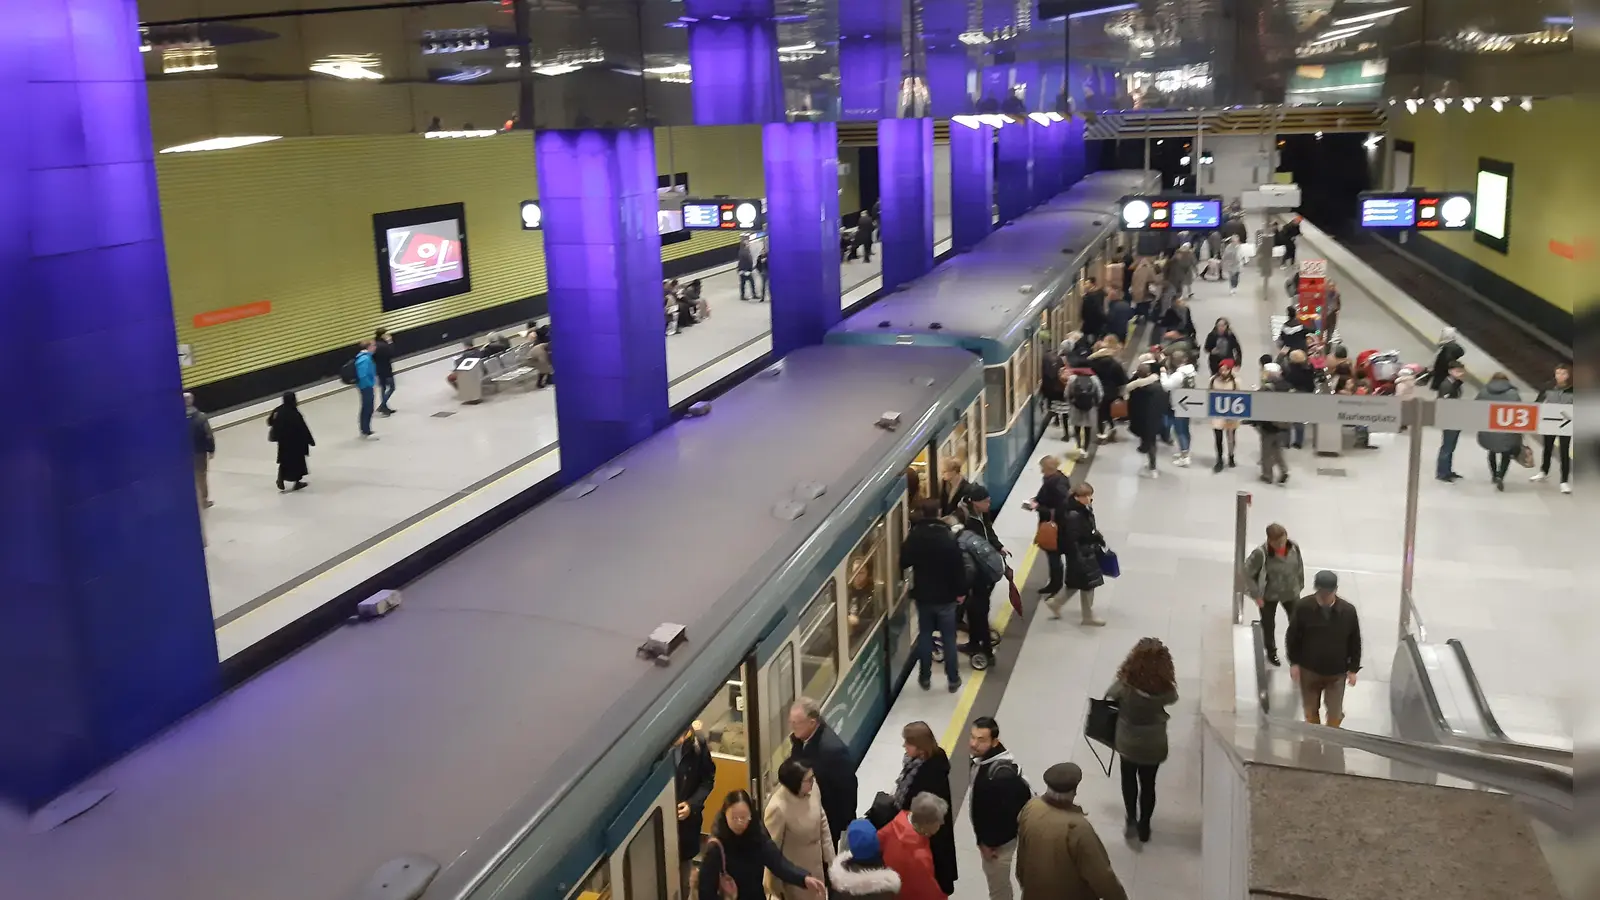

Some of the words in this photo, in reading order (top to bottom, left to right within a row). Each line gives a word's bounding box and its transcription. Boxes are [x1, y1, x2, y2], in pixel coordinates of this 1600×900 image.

[1214, 396, 1246, 414] U6
[1338, 412, 1397, 423] Marienplatz
[1496, 408, 1530, 427] U3
